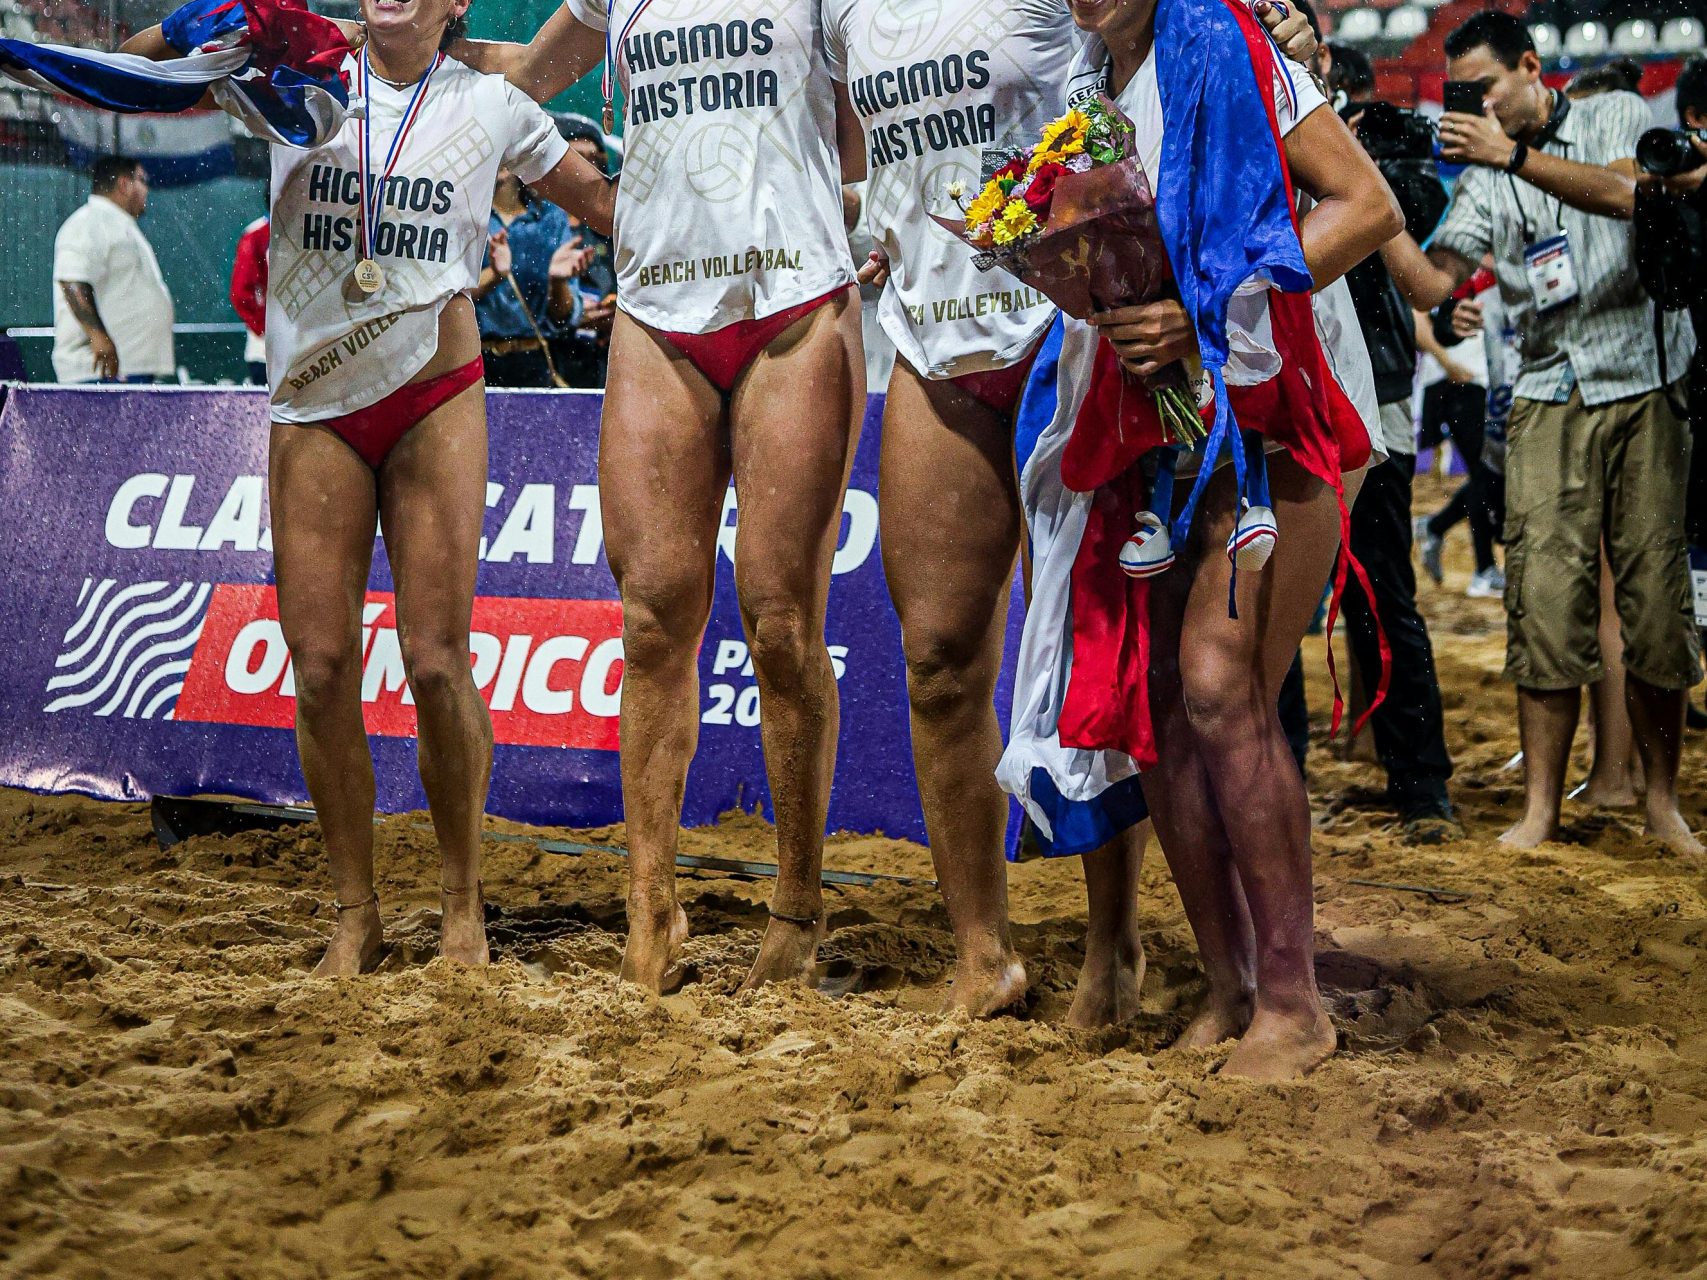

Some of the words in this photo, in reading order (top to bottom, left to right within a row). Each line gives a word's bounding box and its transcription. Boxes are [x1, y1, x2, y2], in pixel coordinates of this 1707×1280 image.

[624, 18, 774, 74] HICIMOS
[631, 69, 778, 126] HISTORIA
[852, 49, 990, 118] HICIMOS
[870, 103, 996, 169] HISTORIA
[303, 213, 449, 263] HISORIA
[640, 260, 696, 287] BEACH
[932, 286, 1048, 323] VOLLEYBALL
[289, 347, 343, 391] BEACH
[341, 310, 406, 357] VOLLE
[224, 602, 624, 717] OMPICO
